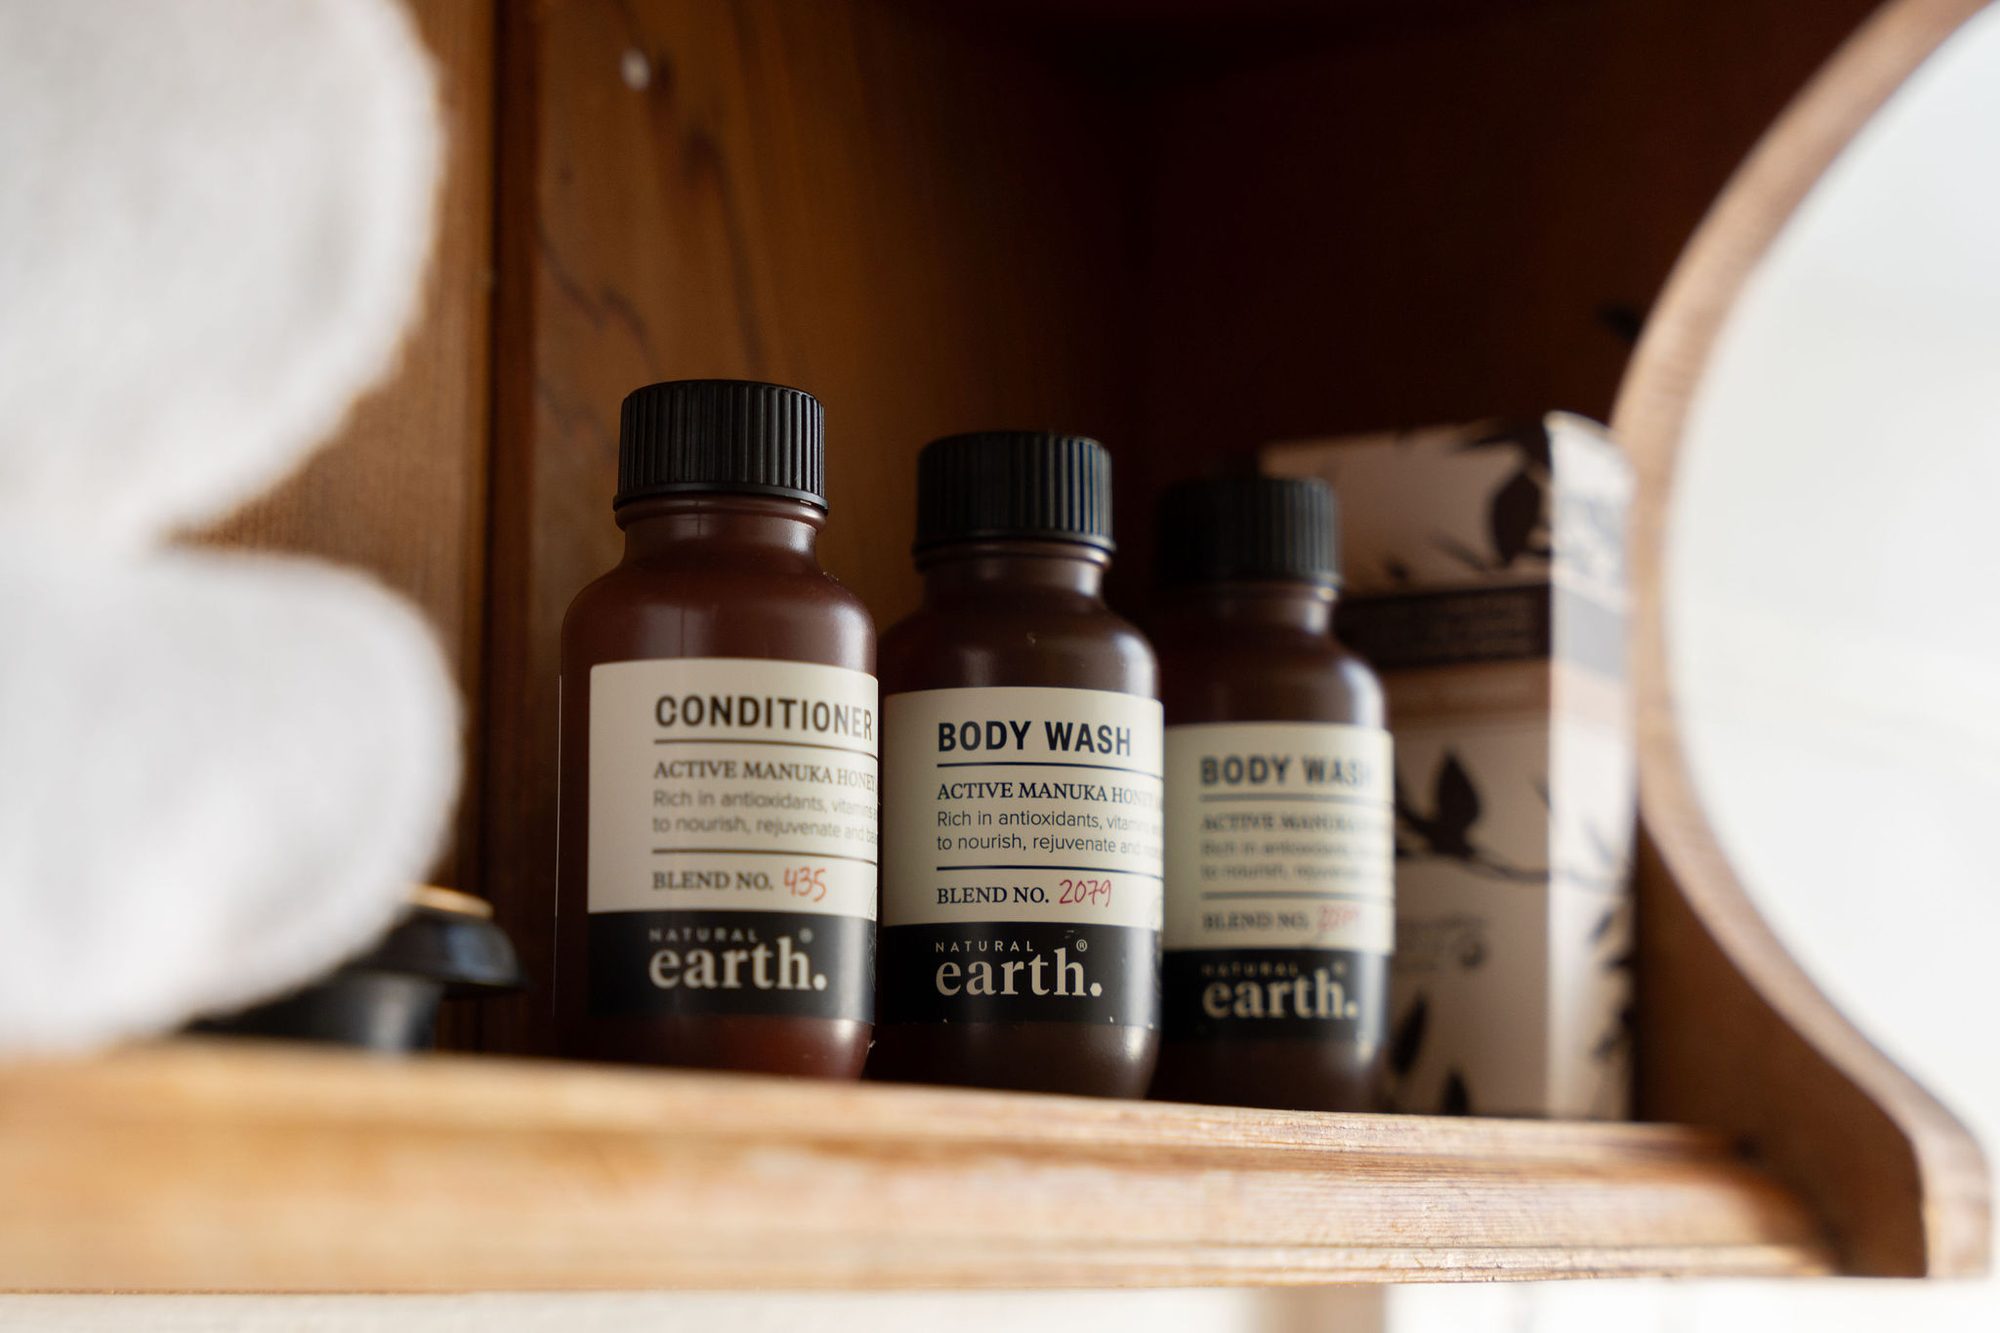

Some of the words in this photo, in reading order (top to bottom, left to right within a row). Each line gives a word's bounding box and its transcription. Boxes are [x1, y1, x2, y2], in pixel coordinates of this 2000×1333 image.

[655, 695, 873, 741] CONDITIONER
[938, 721, 1032, 751] BODY
[1046, 722, 1131, 757] WASH
[654, 761, 737, 779] ACTIVE
[742, 761, 833, 784] MANUKA
[1200, 756, 1293, 785] BODY
[654, 790, 692, 806] Rich
[698, 791, 714, 806] in
[720, 791, 827, 814] antioxidants,
[937, 782, 1013, 800] ACTIVE
[1019, 783, 1108, 802] MANUKA
[652, 817, 670, 832] to
[675, 816, 752, 837] nourish,
[756, 821, 841, 839] rejuvenate
[937, 811, 972, 826] Rich
[978, 811, 992, 825] in
[998, 811, 1103, 830] antioxidants,
[937, 836, 952, 850] to
[958, 834, 1027, 851] nourish,
[1033, 836, 1116, 855] rejuvenate
[652, 871, 730, 890] BLEND
[736, 872, 773, 890] NO.
[783, 866, 827, 902] 435
[937, 887, 1007, 904] BLEND
[1013, 887, 1049, 903] NO.
[1059, 879, 1112, 907] 2079
[648, 928, 758, 941] NATURAL
[935, 940, 1033, 952] NATURAL
[649, 937, 827, 990] earth.
[935, 947, 1103, 997] earth.
[1202, 969, 1359, 1019] earth.
